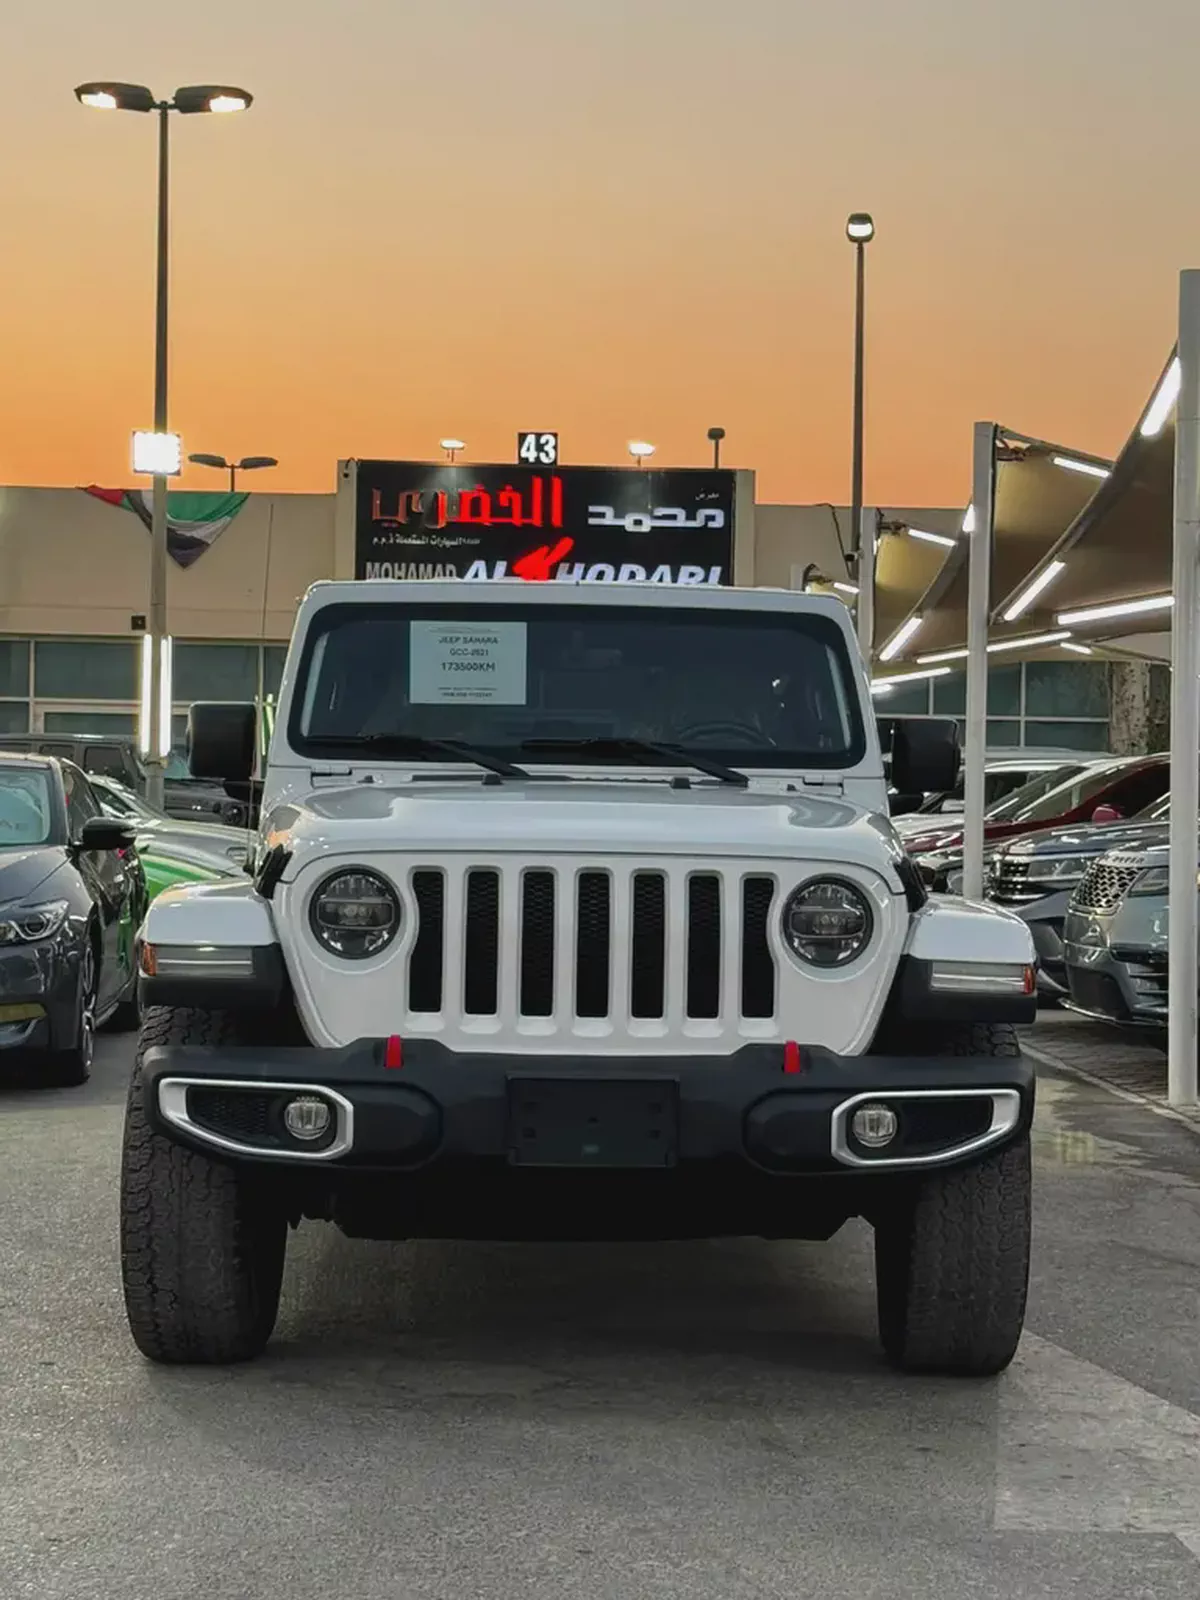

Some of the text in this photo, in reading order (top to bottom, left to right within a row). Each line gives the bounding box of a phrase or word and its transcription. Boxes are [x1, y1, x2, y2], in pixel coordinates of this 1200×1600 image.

[520, 433, 556, 464] 43
[588, 505, 725, 533] محمد
[366, 561, 457, 580] MOHAMAD
[463, 559, 508, 581] AL
[438, 636, 499, 645] JEEP SAHARA
